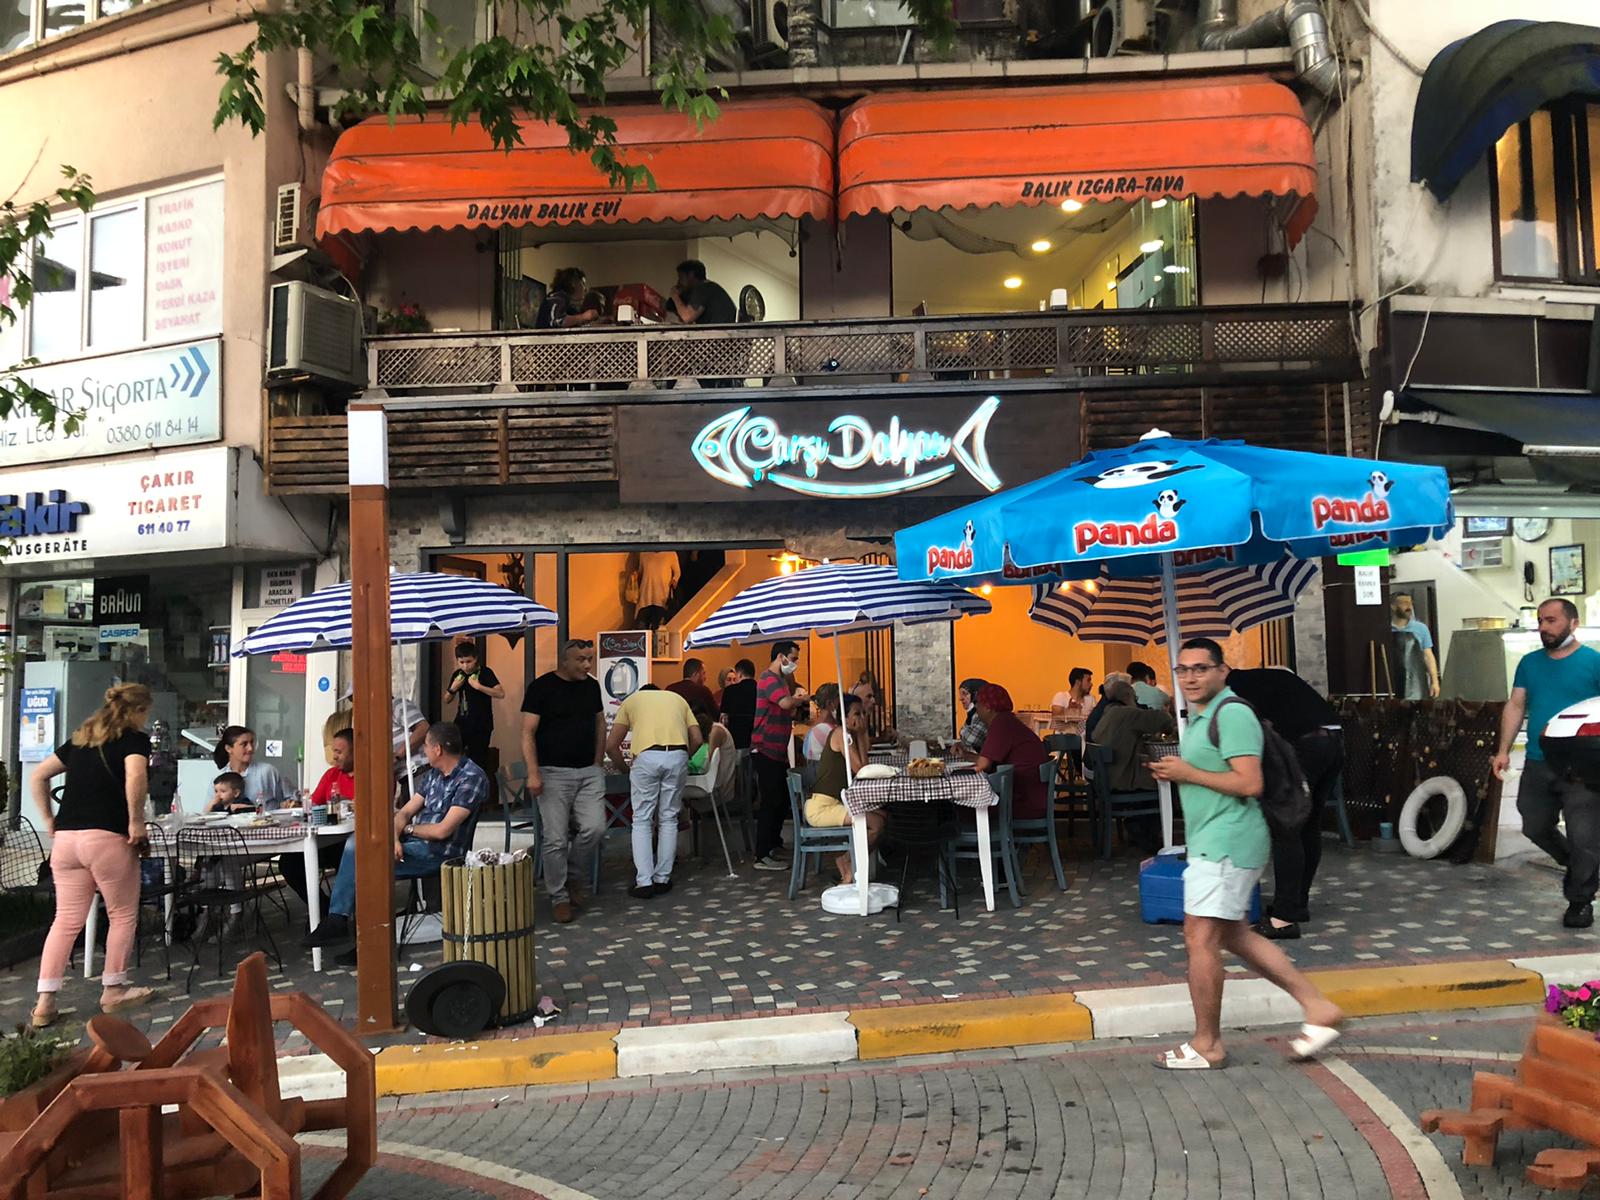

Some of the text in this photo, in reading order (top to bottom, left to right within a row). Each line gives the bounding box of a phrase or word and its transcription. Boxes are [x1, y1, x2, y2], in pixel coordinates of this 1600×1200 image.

[1021, 175, 1184, 198] BALIK IZGARA-TAVA
[466, 197, 623, 220] DALYAN BALIK EVİ
[106, 424, 141, 444] 0380
[145, 421, 161, 440] 611
[165, 418, 182, 438] 84
[187, 415, 199, 434] 14
[140, 470, 194, 493] ÇAKIR
[0, 489, 91, 538] akir
[1312, 491, 1390, 530] panda
[137, 519, 191, 535] 611 40 77
[1073, 512, 1177, 555] panda
[4, 537, 88, 557] AUSGERÄTE
[926, 541, 974, 576] panda
[100, 588, 141, 614] BRAUN
[100, 629, 139, 638] CASPER
